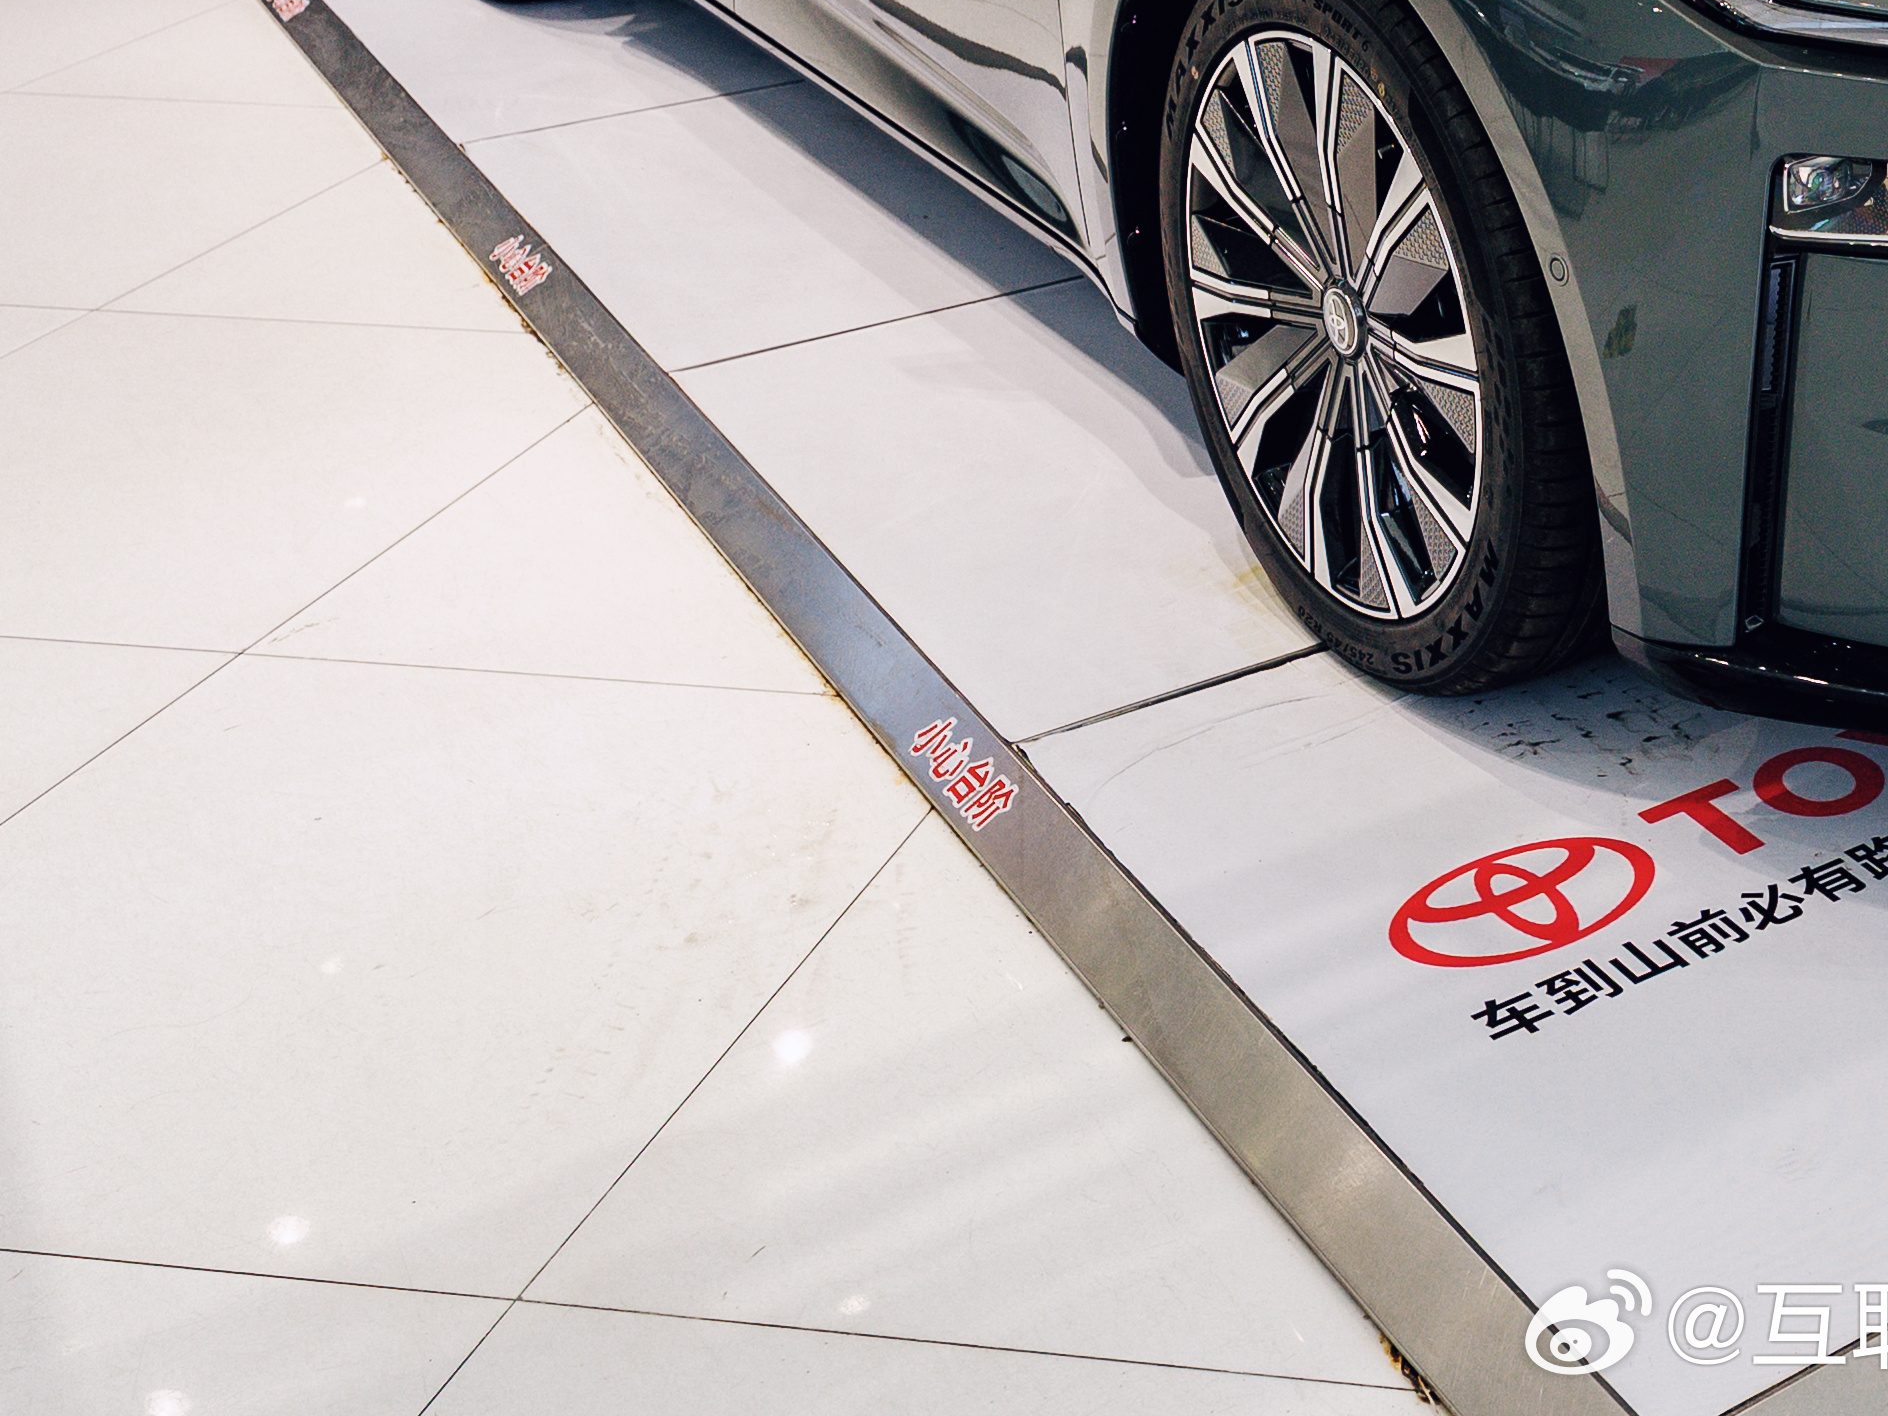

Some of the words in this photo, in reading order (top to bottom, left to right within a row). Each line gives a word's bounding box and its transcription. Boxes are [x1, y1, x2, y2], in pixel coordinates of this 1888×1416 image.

[1390, 536, 1500, 674] MAXXIS
[910, 717, 1018, 831] 小心台阶
